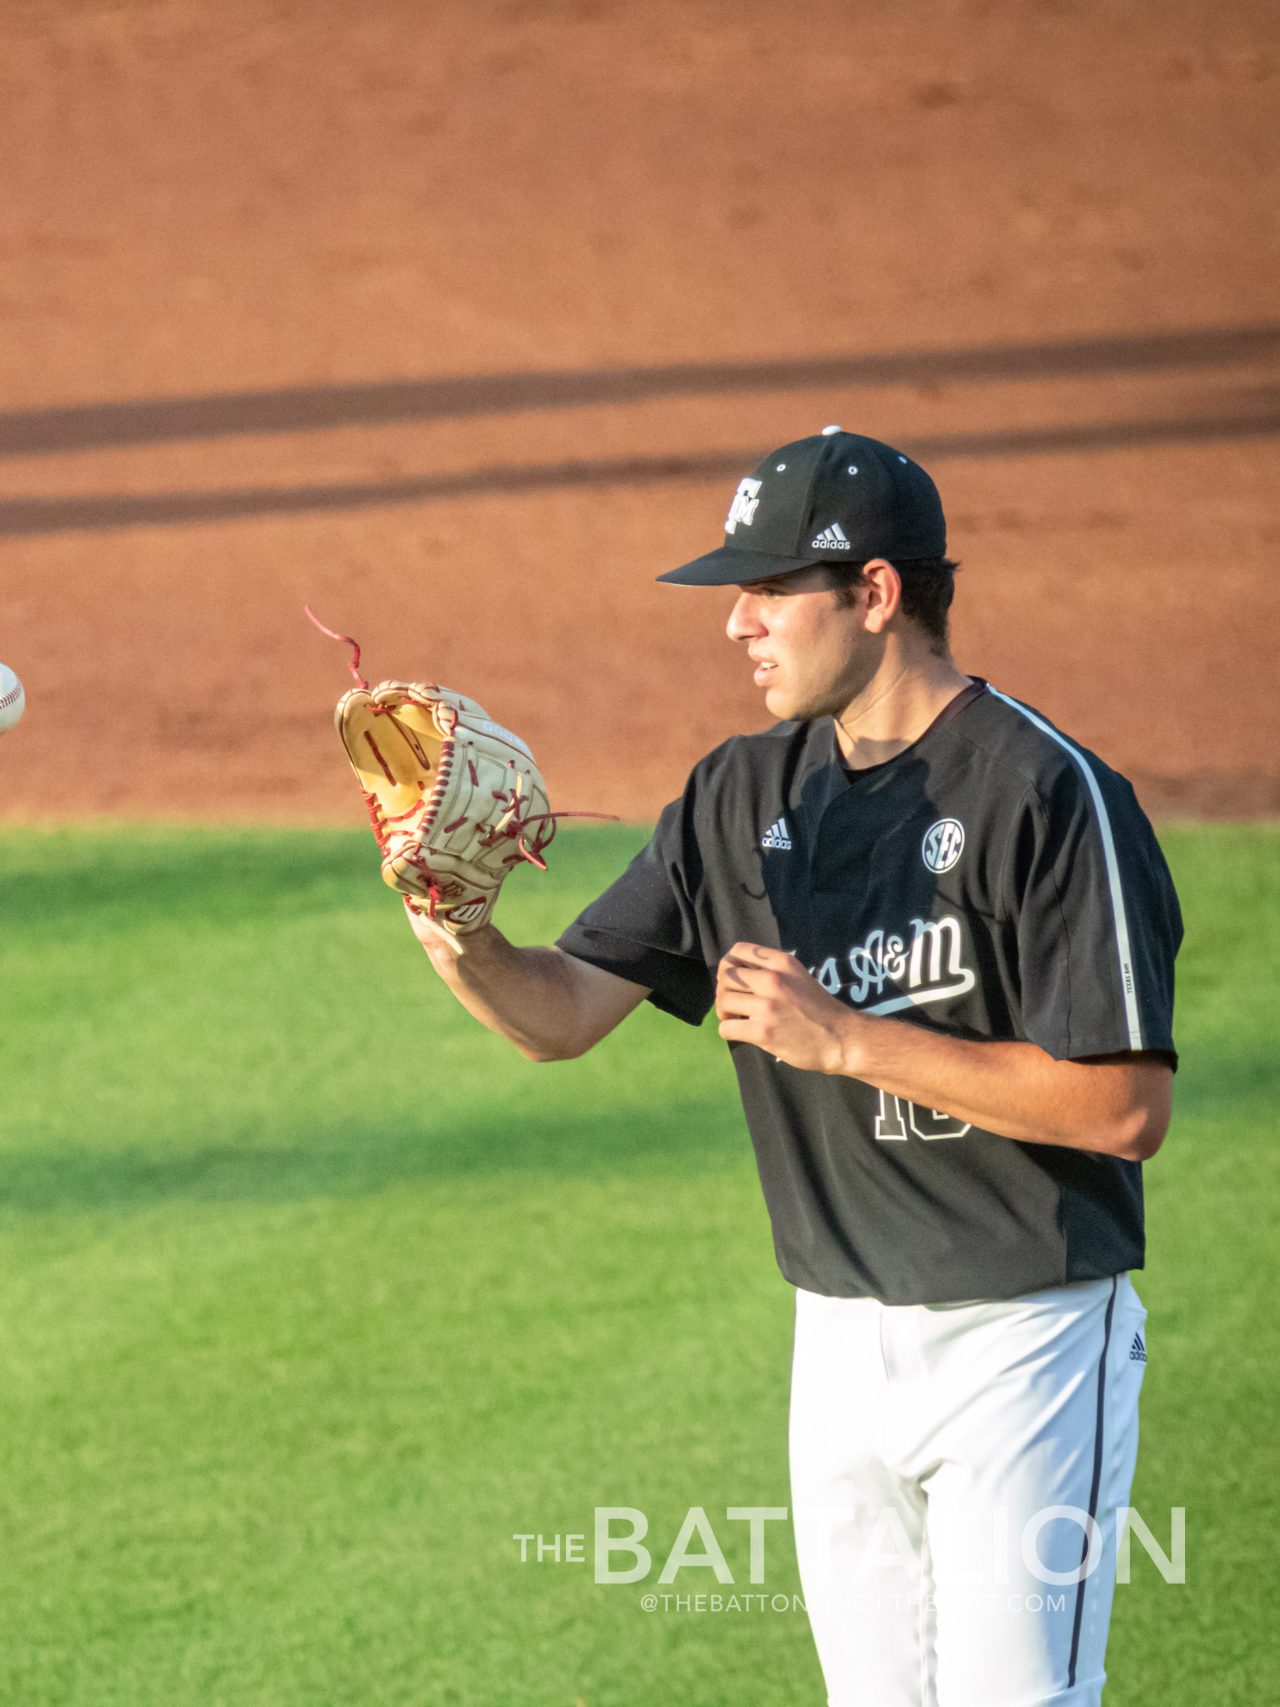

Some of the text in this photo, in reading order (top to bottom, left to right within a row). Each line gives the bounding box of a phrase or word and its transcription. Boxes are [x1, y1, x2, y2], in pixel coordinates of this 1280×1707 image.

[811, 539, 851, 550] adidas
[761, 835, 792, 850] adidas
[925, 821, 963, 871] SEC
[849, 913, 975, 1004] A&M
